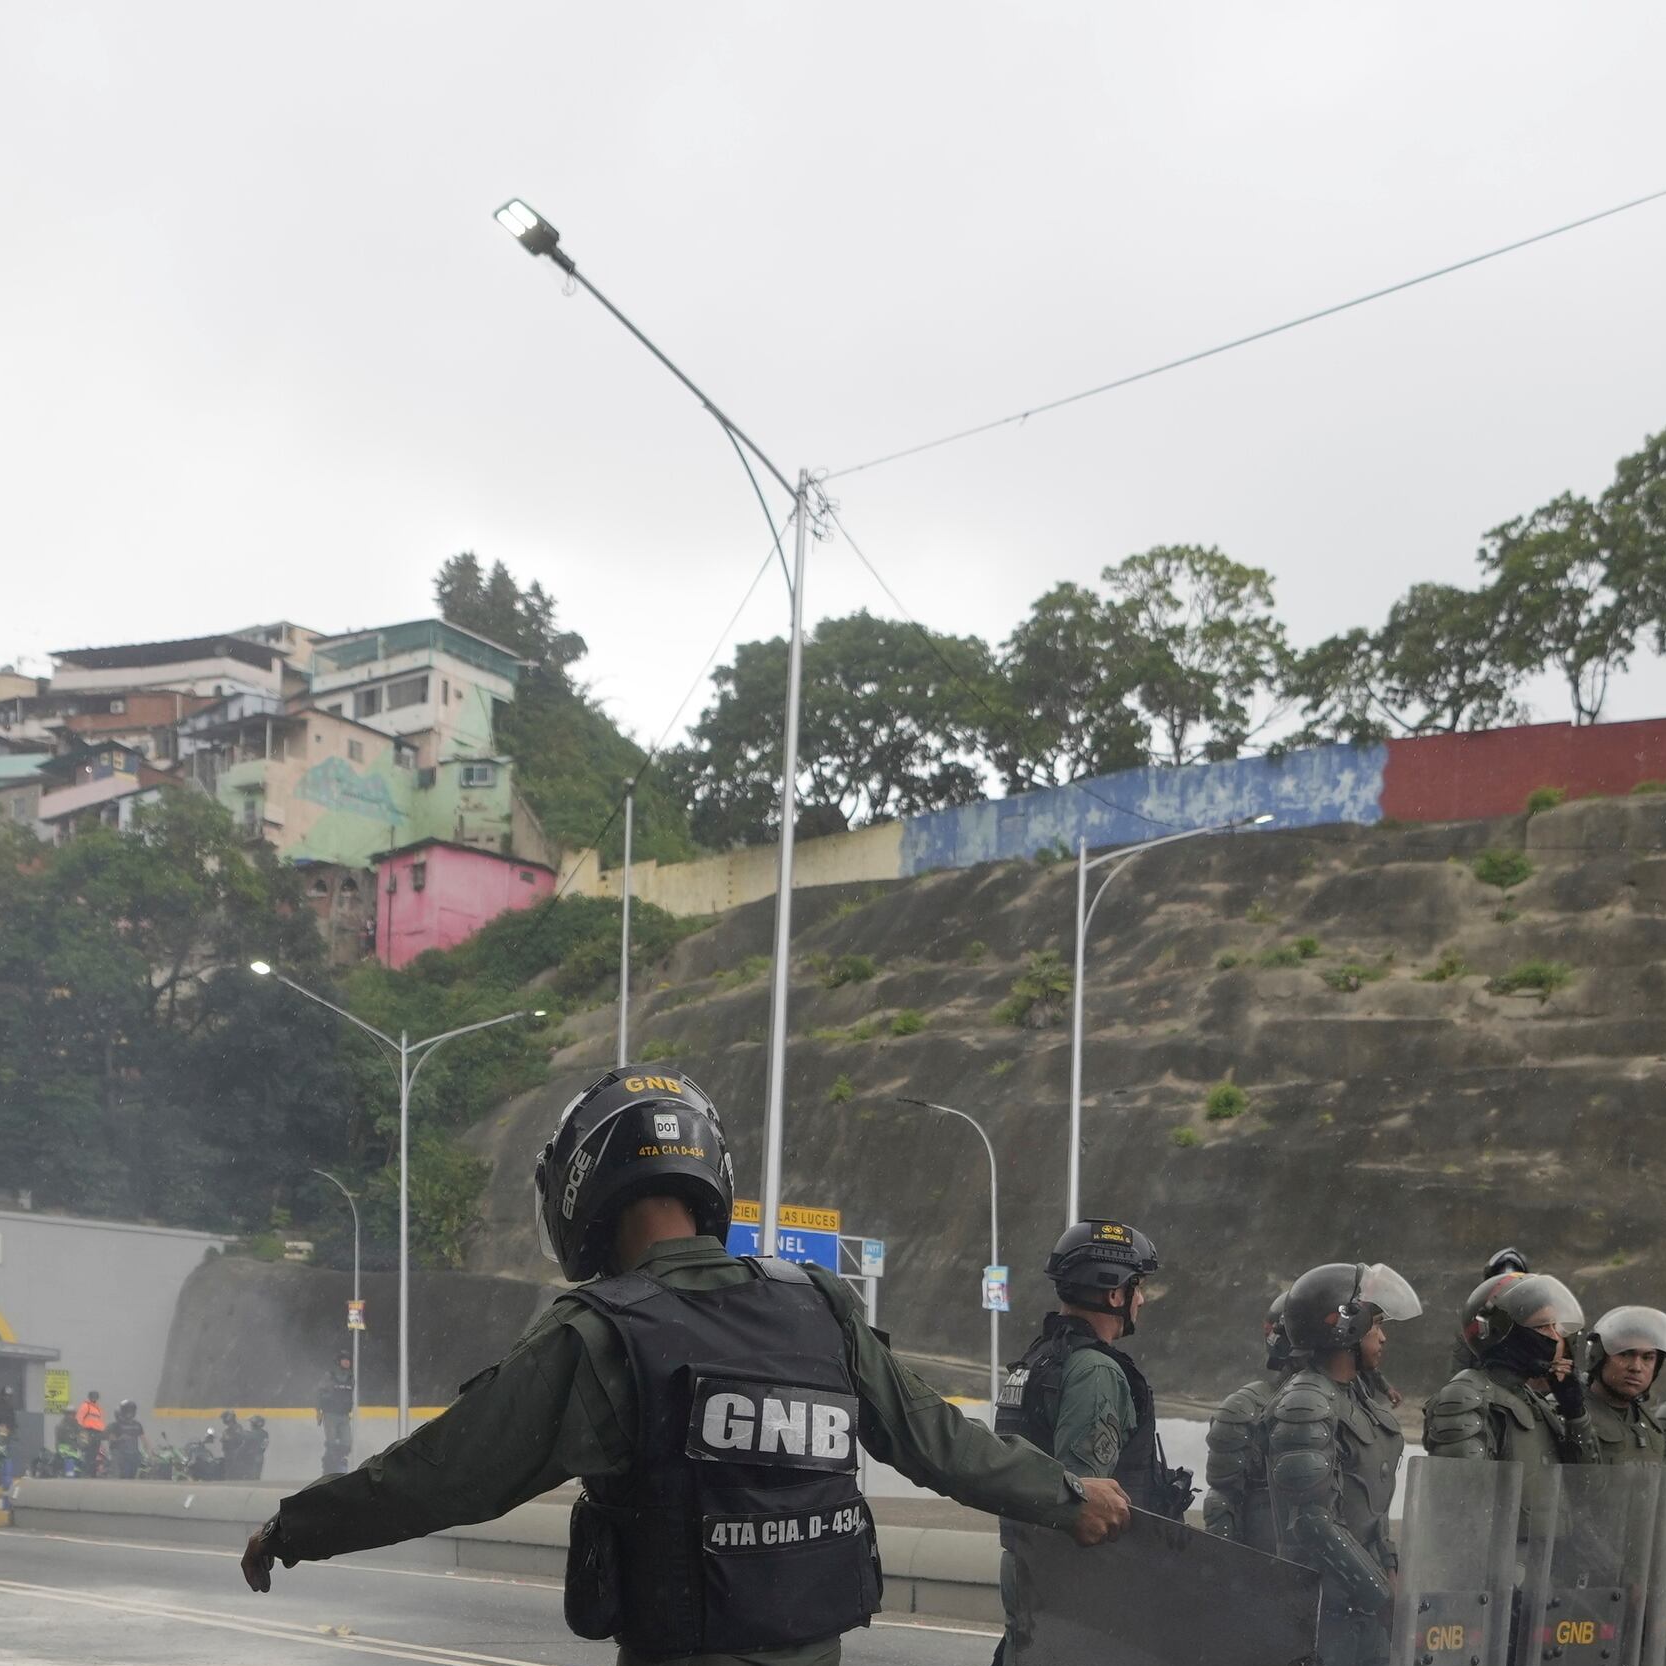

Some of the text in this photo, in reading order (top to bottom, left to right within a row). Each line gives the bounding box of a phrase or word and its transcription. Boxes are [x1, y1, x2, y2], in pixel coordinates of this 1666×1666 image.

[624, 1076, 682, 1094] GNB
[657, 1122, 677, 1133] DOT
[638, 1146, 659, 1157] 4TA
[562, 1148, 592, 1221] EDGE
[801, 1212, 836, 1228] LUCES
[751, 1232, 806, 1254] TNEL
[701, 1392, 851, 1460] GNB
[710, 1522, 757, 1547] 4TA
[761, 1518, 805, 1545] CIA.
[1426, 1625, 1464, 1651] GNB
[1555, 1621, 1595, 1645] GNB
